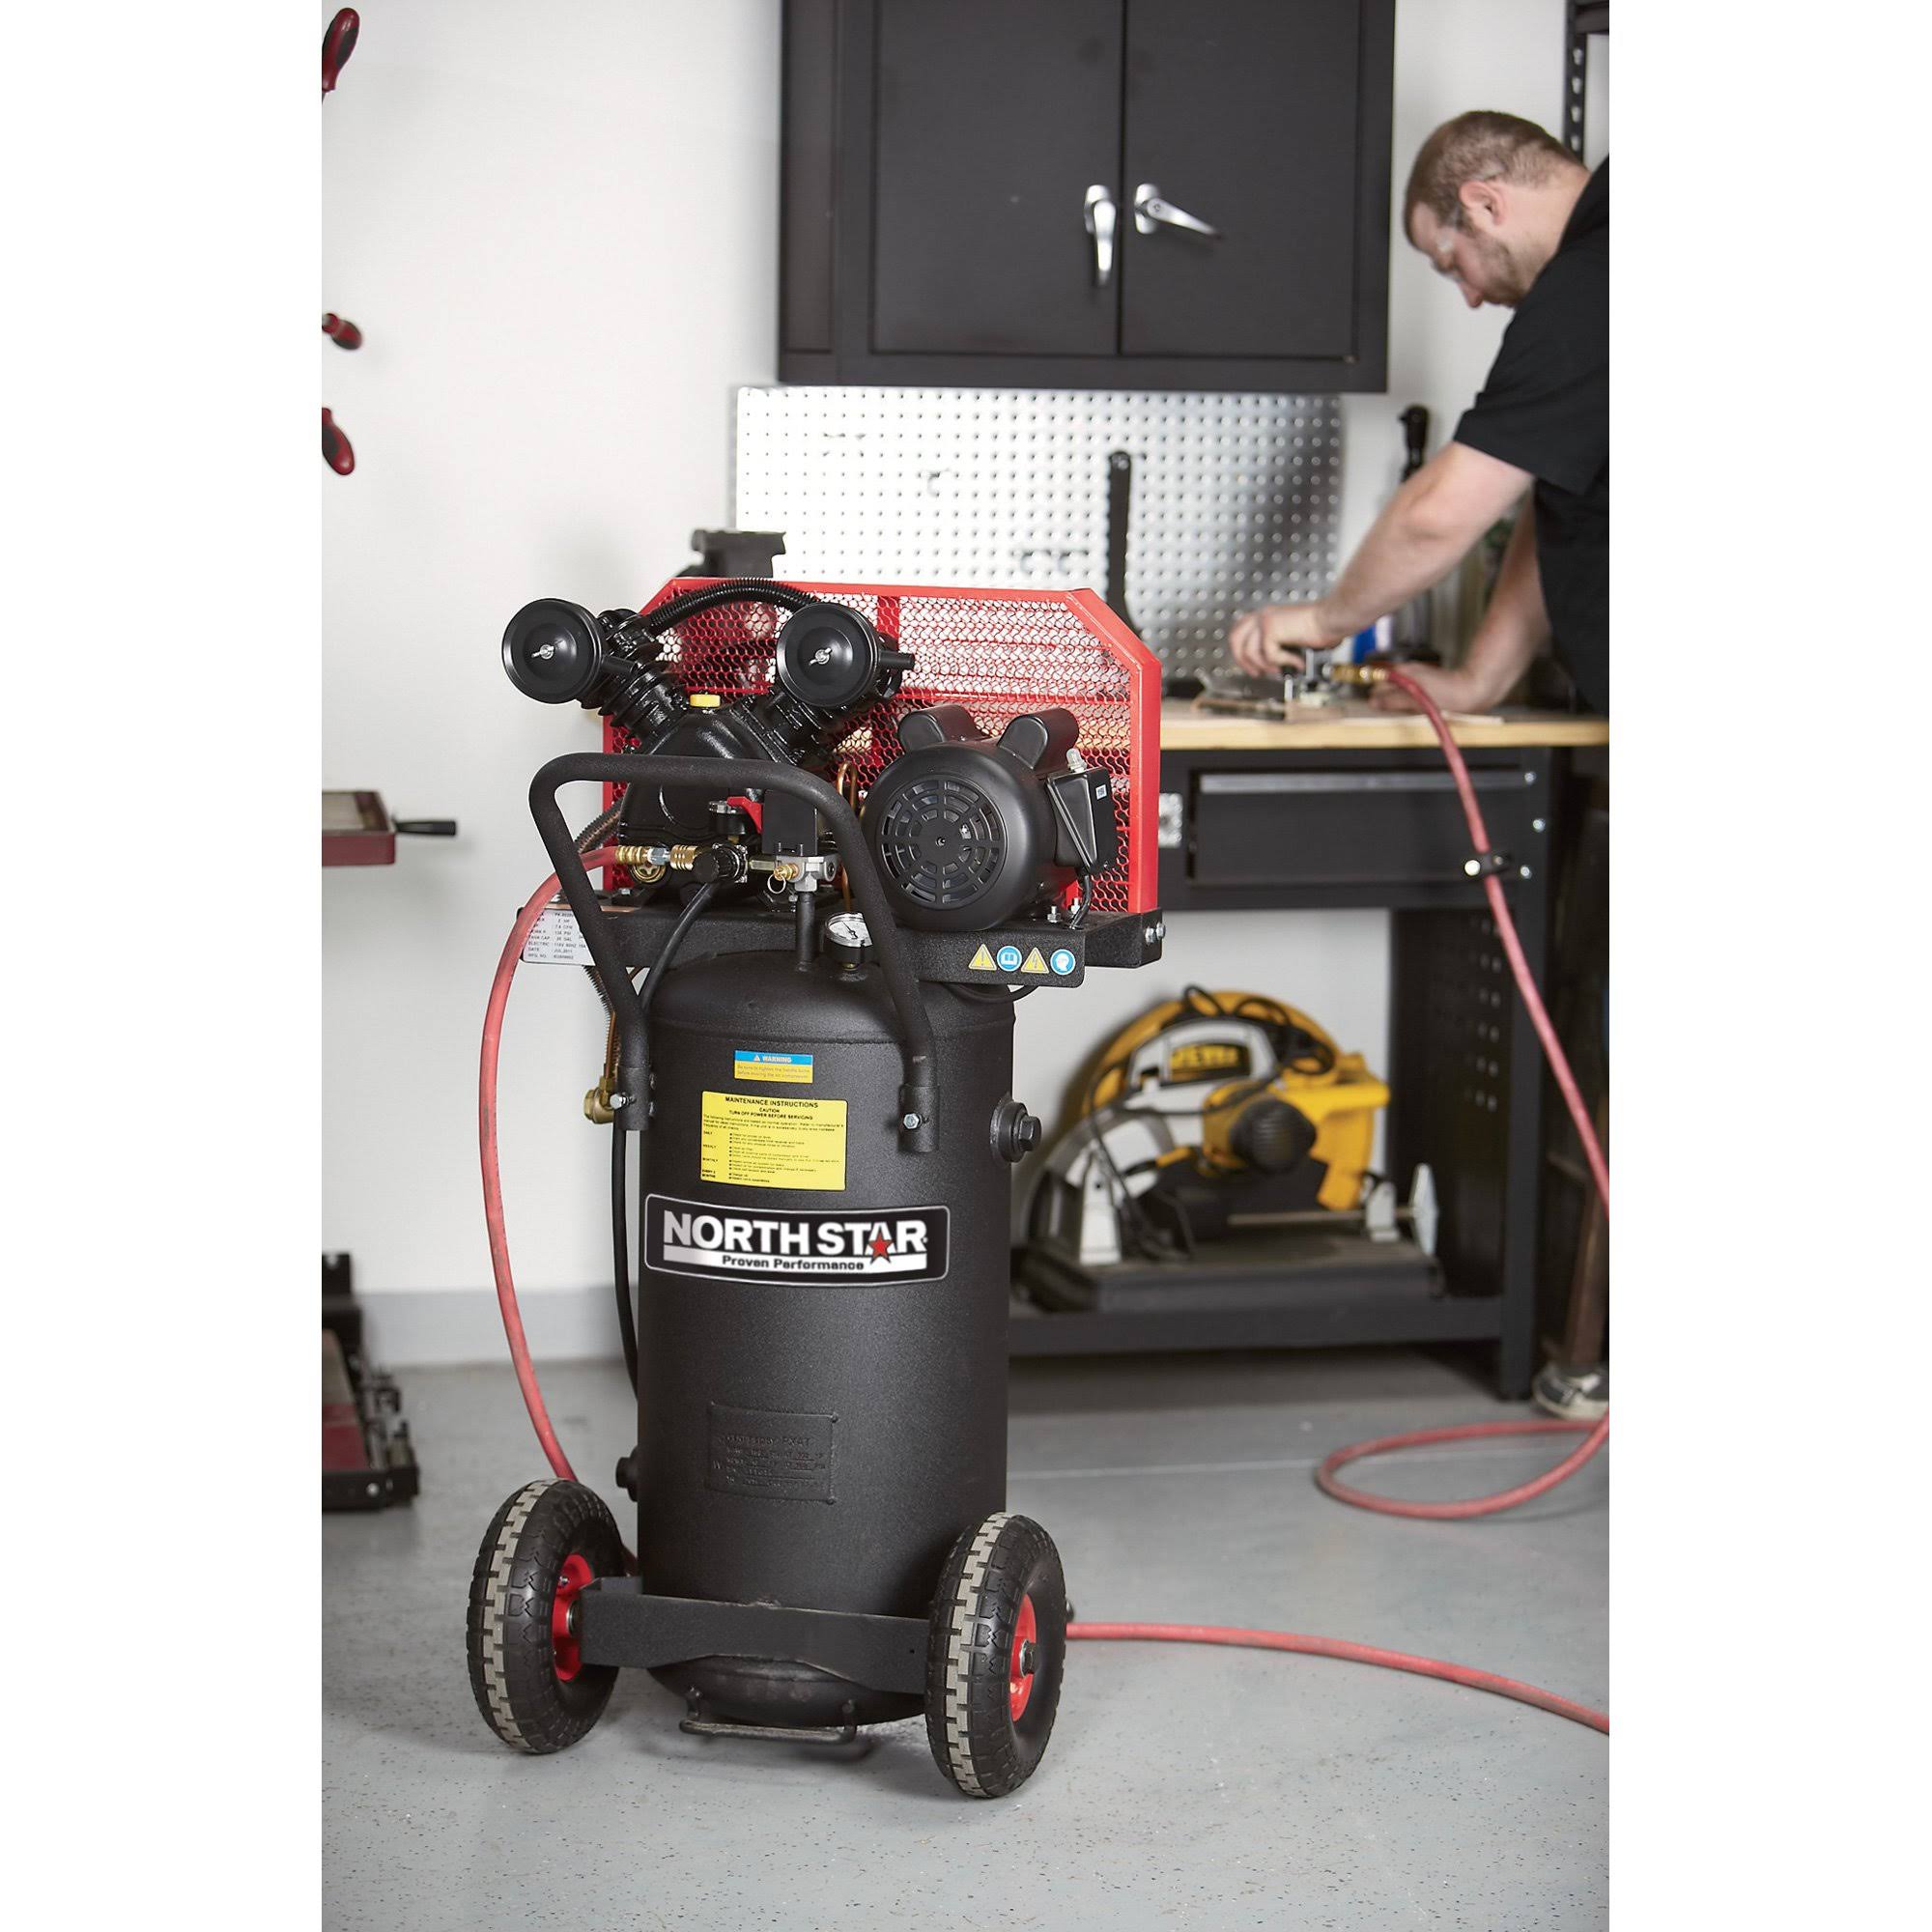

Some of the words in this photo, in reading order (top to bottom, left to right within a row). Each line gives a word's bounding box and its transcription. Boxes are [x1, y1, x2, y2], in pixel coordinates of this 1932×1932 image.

[725, 1096, 769, 1106] MAINTENANCE
[769, 1100, 818, 1109] INSTRUCTIONS
[663, 1208, 810, 1255] NORTH
[722, 1254, 769, 1268] Proven
[773, 1258, 865, 1270] Performance
